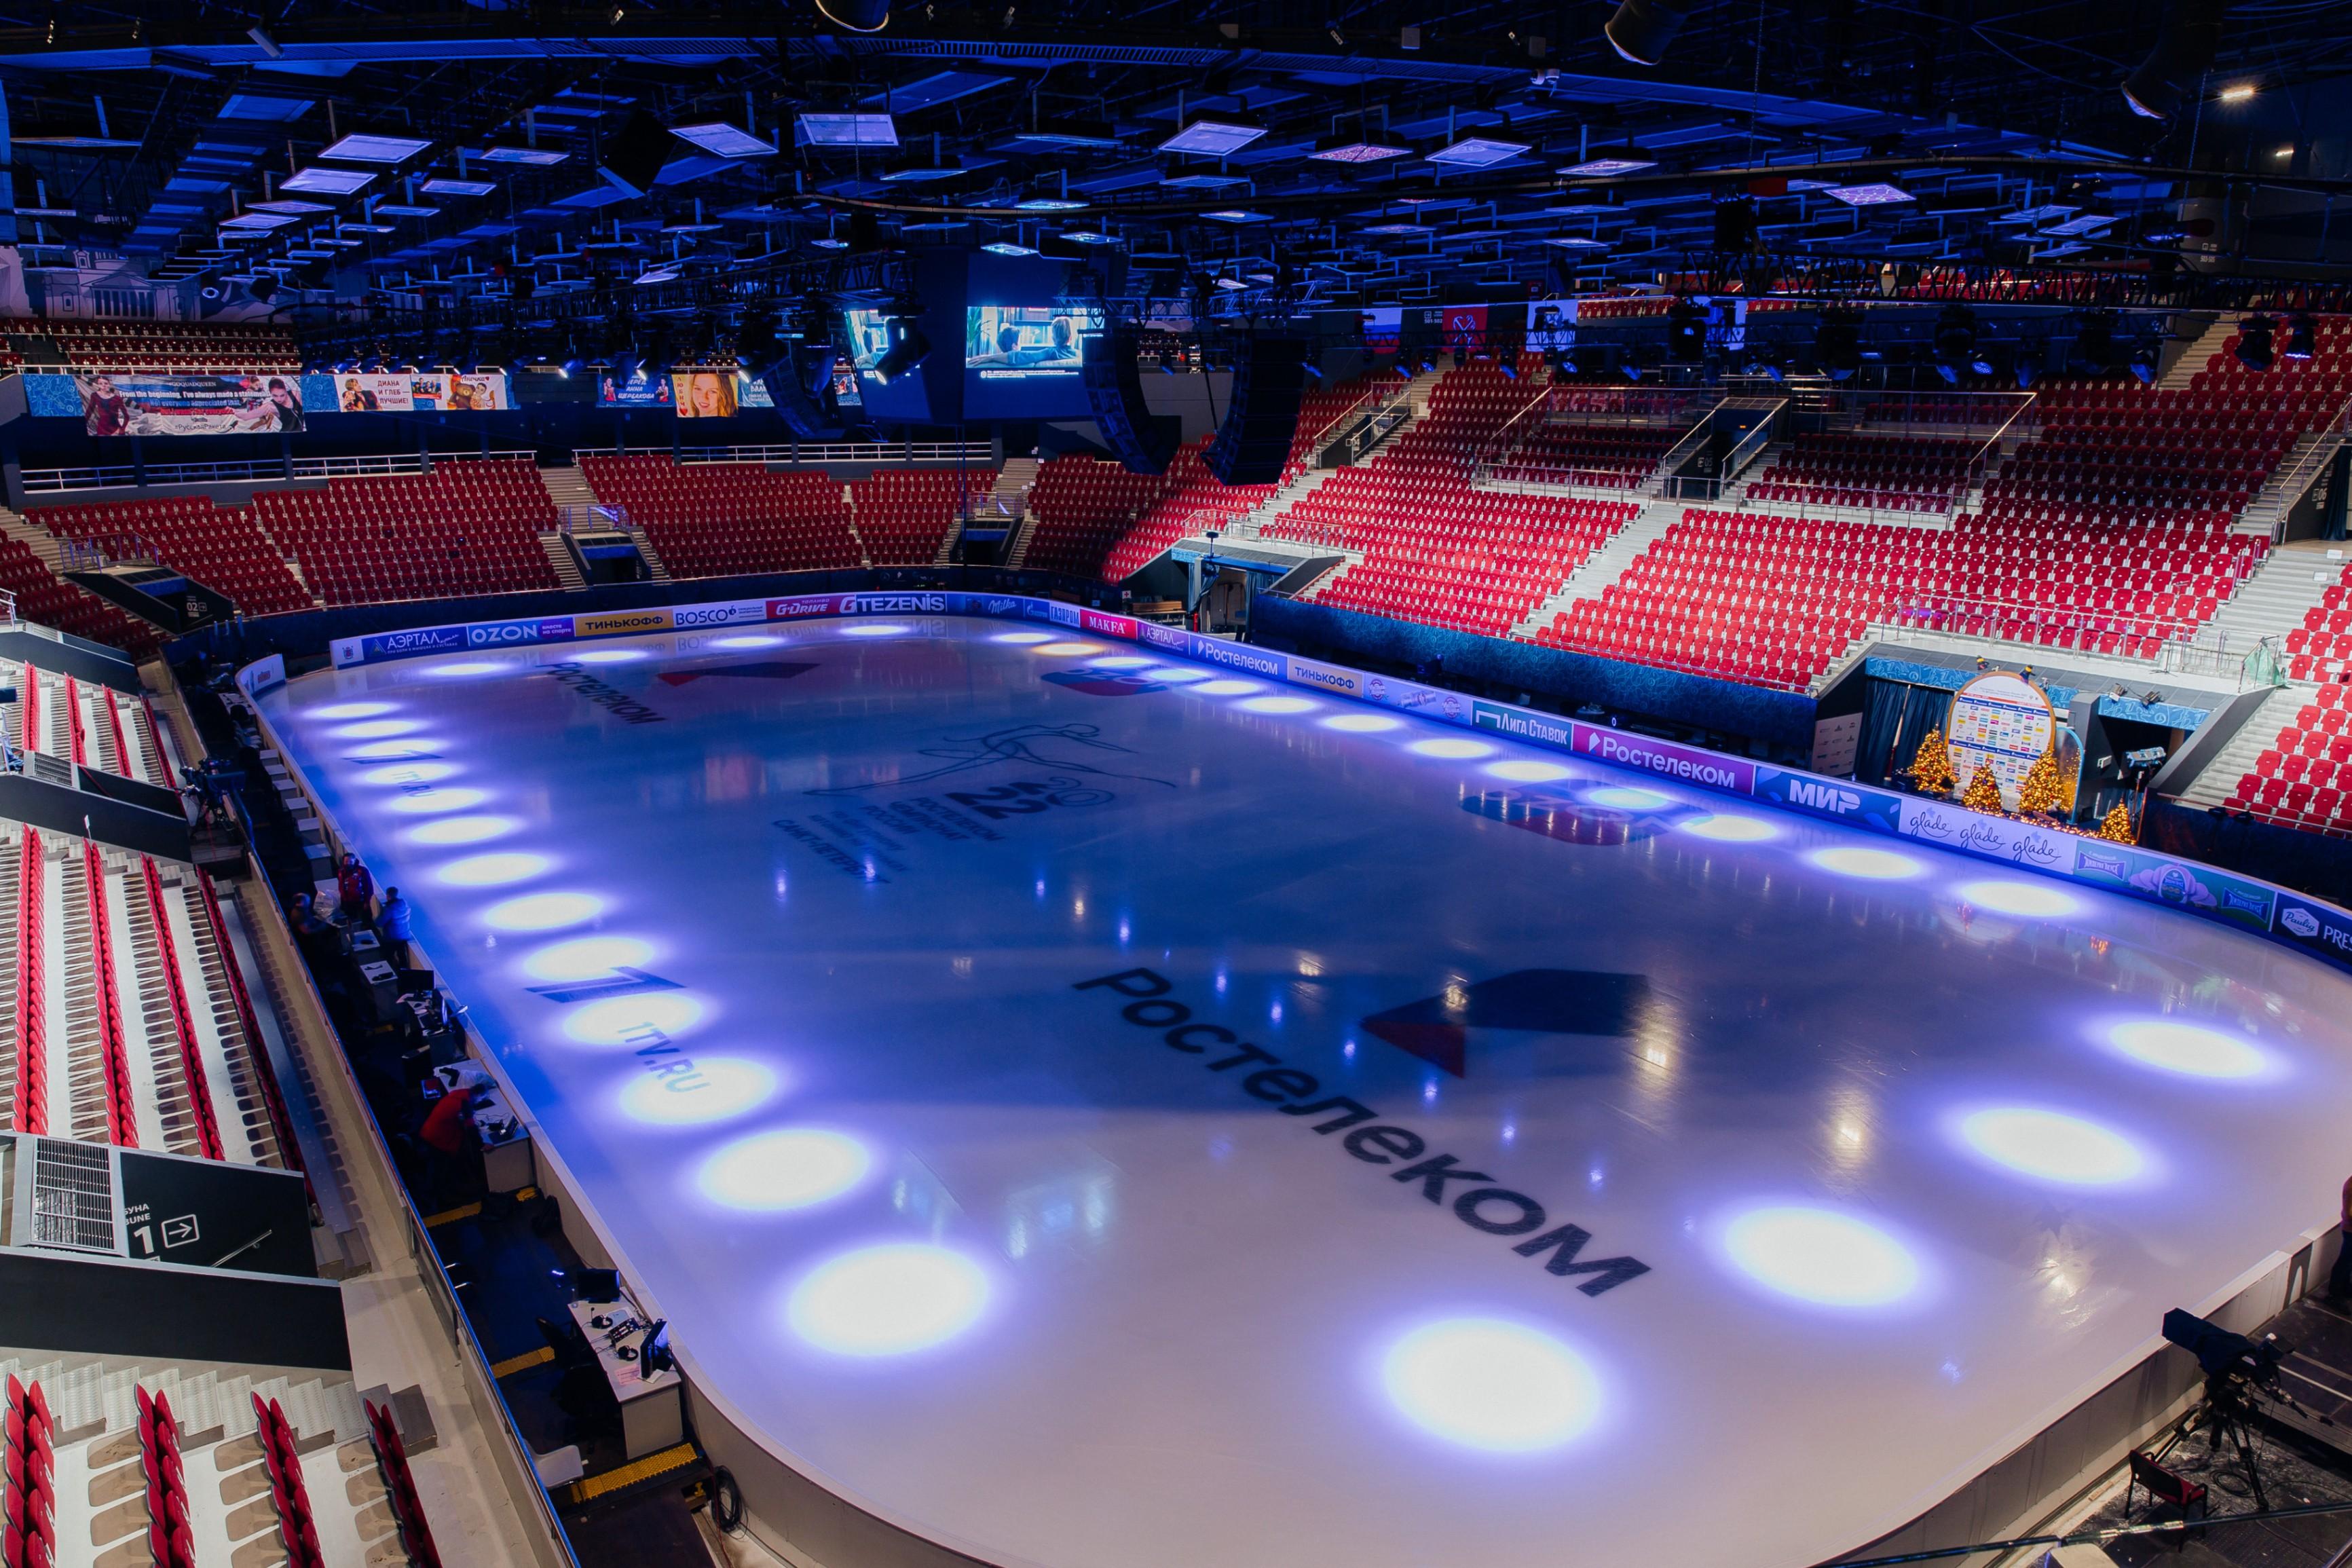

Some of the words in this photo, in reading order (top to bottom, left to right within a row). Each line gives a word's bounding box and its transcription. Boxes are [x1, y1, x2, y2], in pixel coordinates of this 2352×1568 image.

[187, 603, 198, 611] 02
[988, 598, 1017, 614] Milka
[1051, 606, 1079, 625] ГАЗПРОМ
[585, 616, 663, 631] ТИНЬКОФФ
[675, 609, 728, 626] BOSCO
[1088, 616, 1125, 635] MAKFA
[387, 631, 441, 650] АЭРТАЛ
[471, 624, 538, 643] OZON
[1146, 626, 1174, 644] АЭРТАЛ
[1206, 642, 1278, 675] Ростелеком
[1294, 666, 1355, 690] ТИНЬКОФФ
[1602, 736, 1735, 789] Ростелеком
[1789, 779, 1861, 814] МИР
[1910, 810, 1954, 839] glade
[1960, 822, 2006, 851] glade
[2012, 836, 2062, 864] glade
[2285, 912, 2315, 933] Paulig
[617, 1021, 713, 1094] 1TV.RU
[1070, 966, 1653, 1298] Ростелеком
